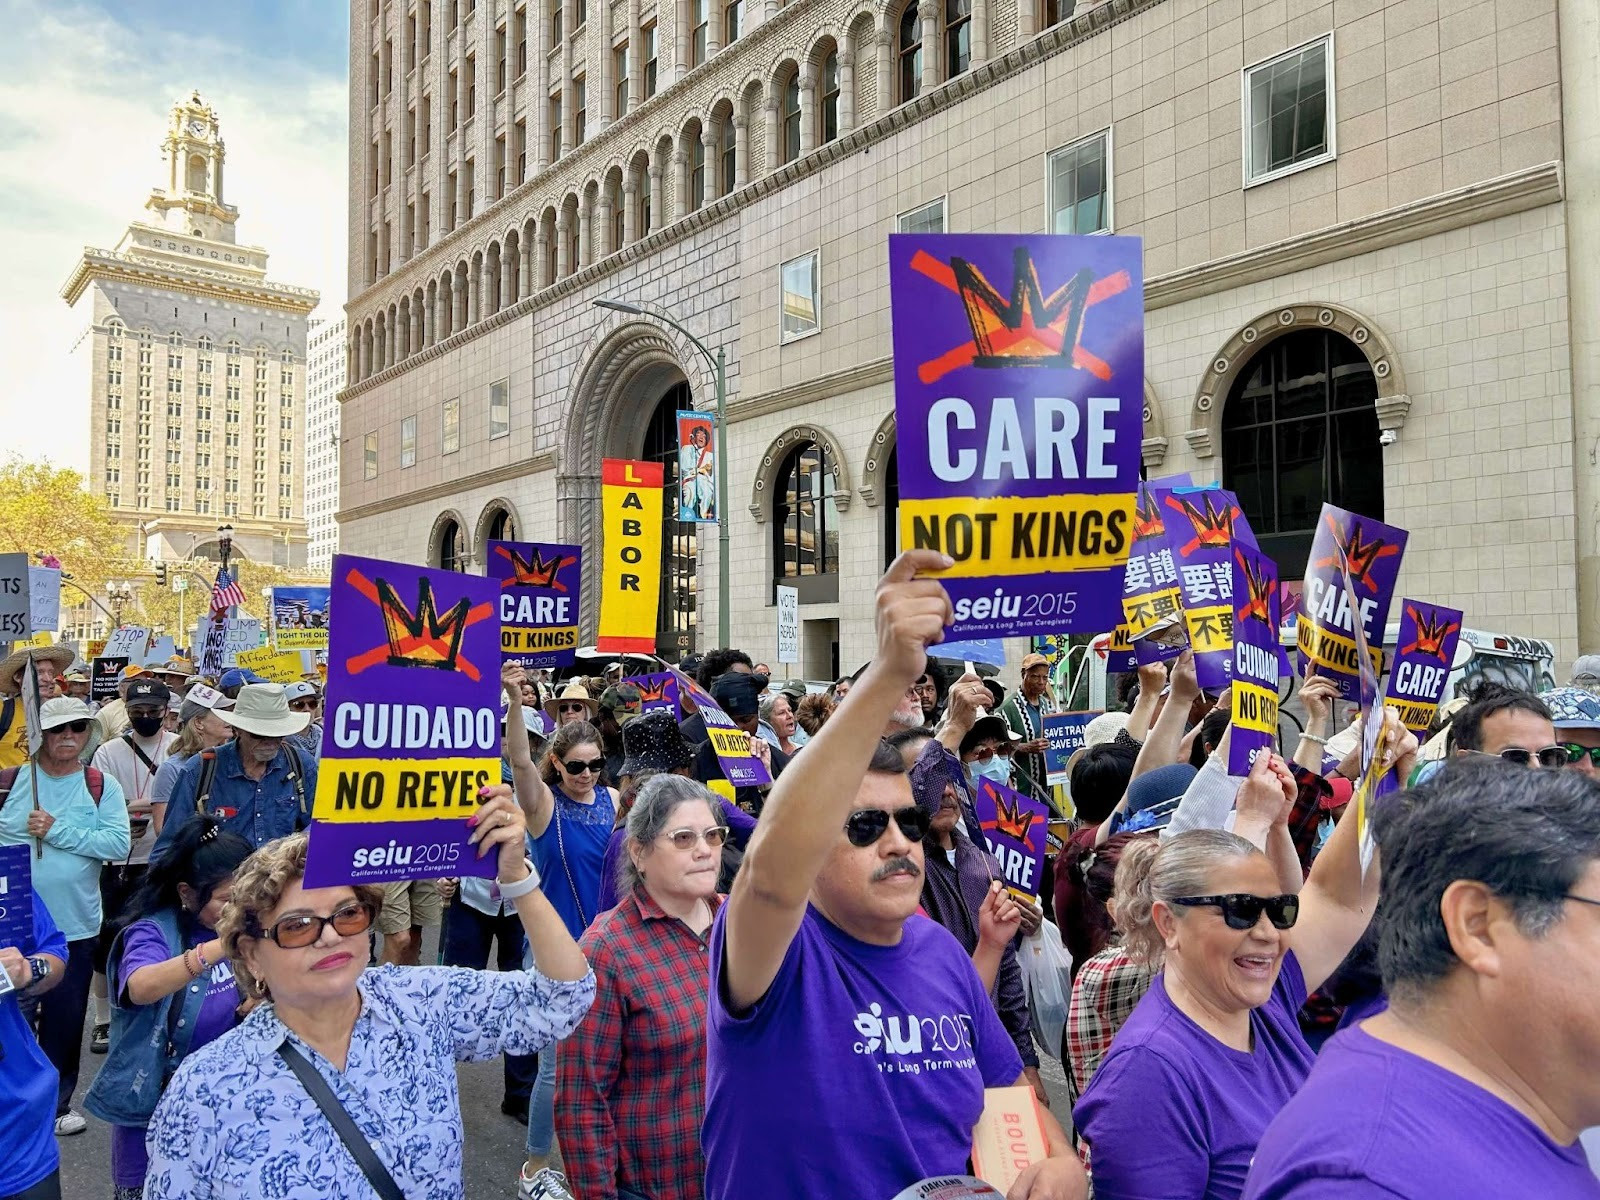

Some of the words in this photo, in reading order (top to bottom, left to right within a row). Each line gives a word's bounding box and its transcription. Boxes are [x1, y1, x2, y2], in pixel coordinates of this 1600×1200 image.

[927, 397, 1120, 482] CARE
[620, 464, 643, 592] LABOR
[913, 513, 998, 562] NOT
[1011, 509, 1127, 560] KINGS
[500, 593, 571, 624] CARE
[954, 588, 1022, 621] seiu
[1023, 592, 1078, 617] 2015
[1306, 577, 1378, 639] CARE
[0, 613, 26, 635] ESS
[228, 620, 257, 631] UMP
[952, 622, 994, 632] California's
[996, 621, 1014, 630] Long
[1016, 619, 1033, 627] Term
[1035, 617, 1073, 627] Caregivers
[113, 629, 144, 642] STOP
[501, 632, 521, 648] OT
[526, 631, 575, 649] KINGS
[678, 635, 689, 646] 436
[115, 643, 133, 653] THE
[1395, 661, 1446, 699] CARE
[1240, 691, 1257, 721] NO
[1403, 706, 1433, 726] KINGS
[333, 702, 495, 750] CUIDADO
[1044, 726, 1064, 738] SAVE
[1065, 725, 1087, 735] TRAN
[713, 734, 726, 751] NO
[726, 735, 750, 752] REYES
[1050, 738, 1071, 750] SAVE
[1072, 737, 1085, 747] BA
[335, 771, 384, 810] NO
[396, 770, 491, 809] REYES
[352, 840, 413, 868] seiu
[413, 843, 460, 864] 2015
[351, 868, 389, 877] California's
[390, 866, 405, 874] Long
[407, 865, 422, 873] Term
[424, 863, 456, 872] Caregivers
[921, 1178, 963, 1193] OAKLAND
